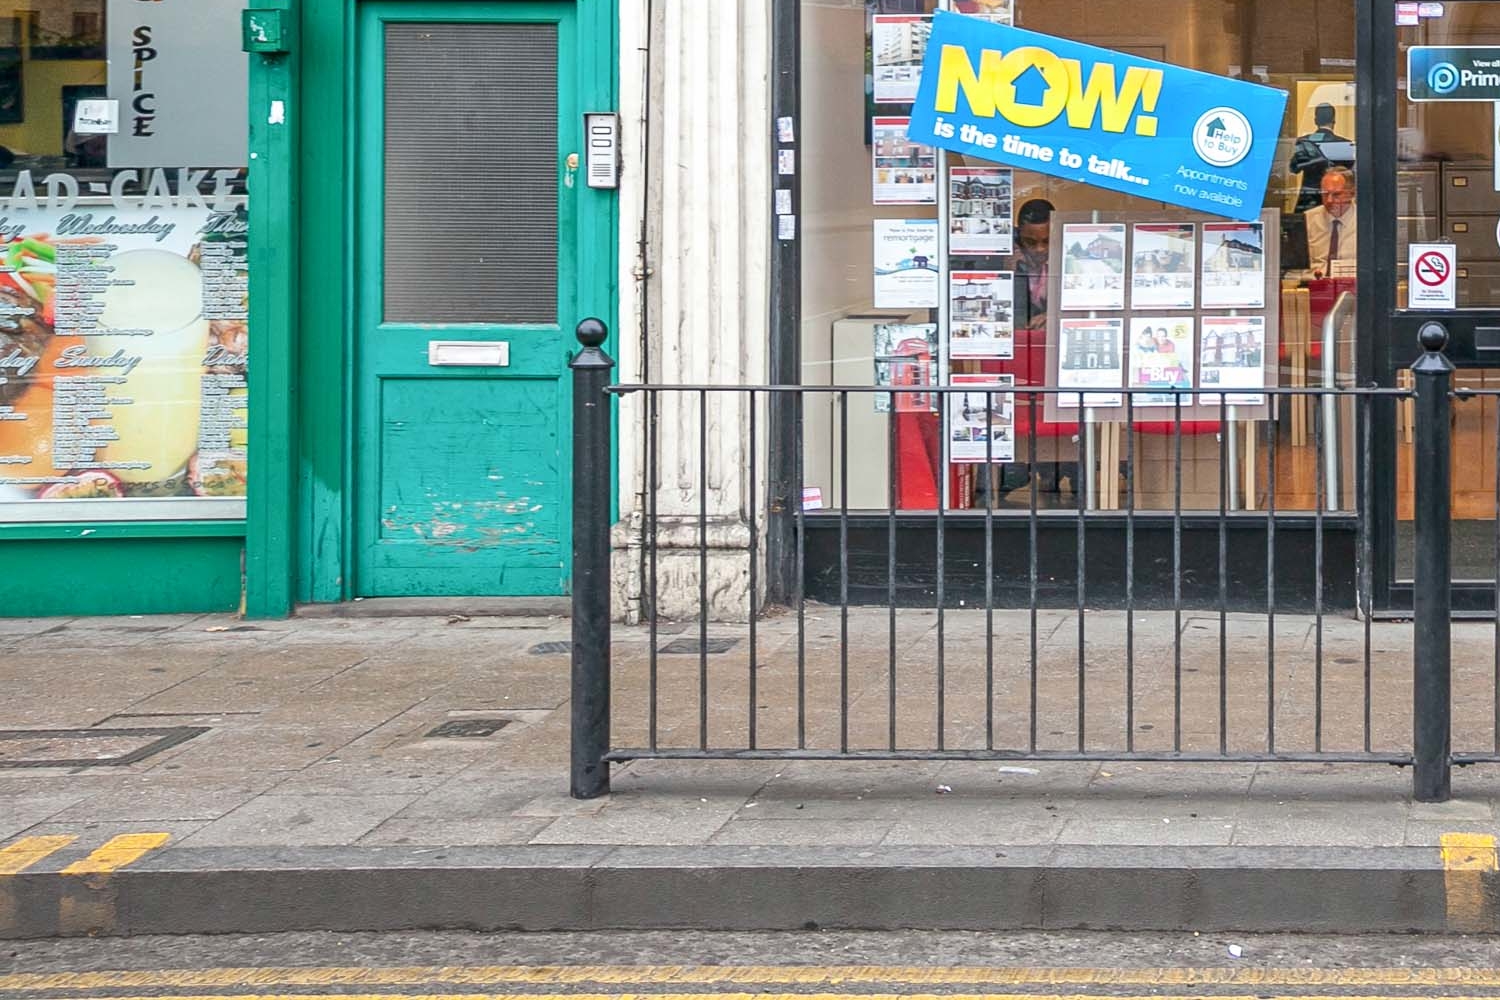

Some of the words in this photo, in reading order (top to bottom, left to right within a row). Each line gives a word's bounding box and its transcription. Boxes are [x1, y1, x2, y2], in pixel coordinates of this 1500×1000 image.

[1472, 60, 1490, 68] View
[1491, 60, 1500, 68] all
[132, 25, 157, 137] SPICE
[934, 44, 1164, 138] NOW!
[1215, 130, 1241, 144] Help
[1218, 142, 1238, 156] Buy
[933, 117, 955, 139] is
[960, 123, 997, 149] the
[1002, 134, 1054, 163] time
[1059, 147, 1083, 169] to
[1088, 154, 1150, 186] talk...
[1176, 165, 1248, 191] Appointments
[1174, 184, 1198, 197] now
[1198, 188, 1243, 208] available
[55, 213, 177, 242] Wednesday
[883, 234, 935, 244] remortgage
[54, 344, 144, 376] Sunday
